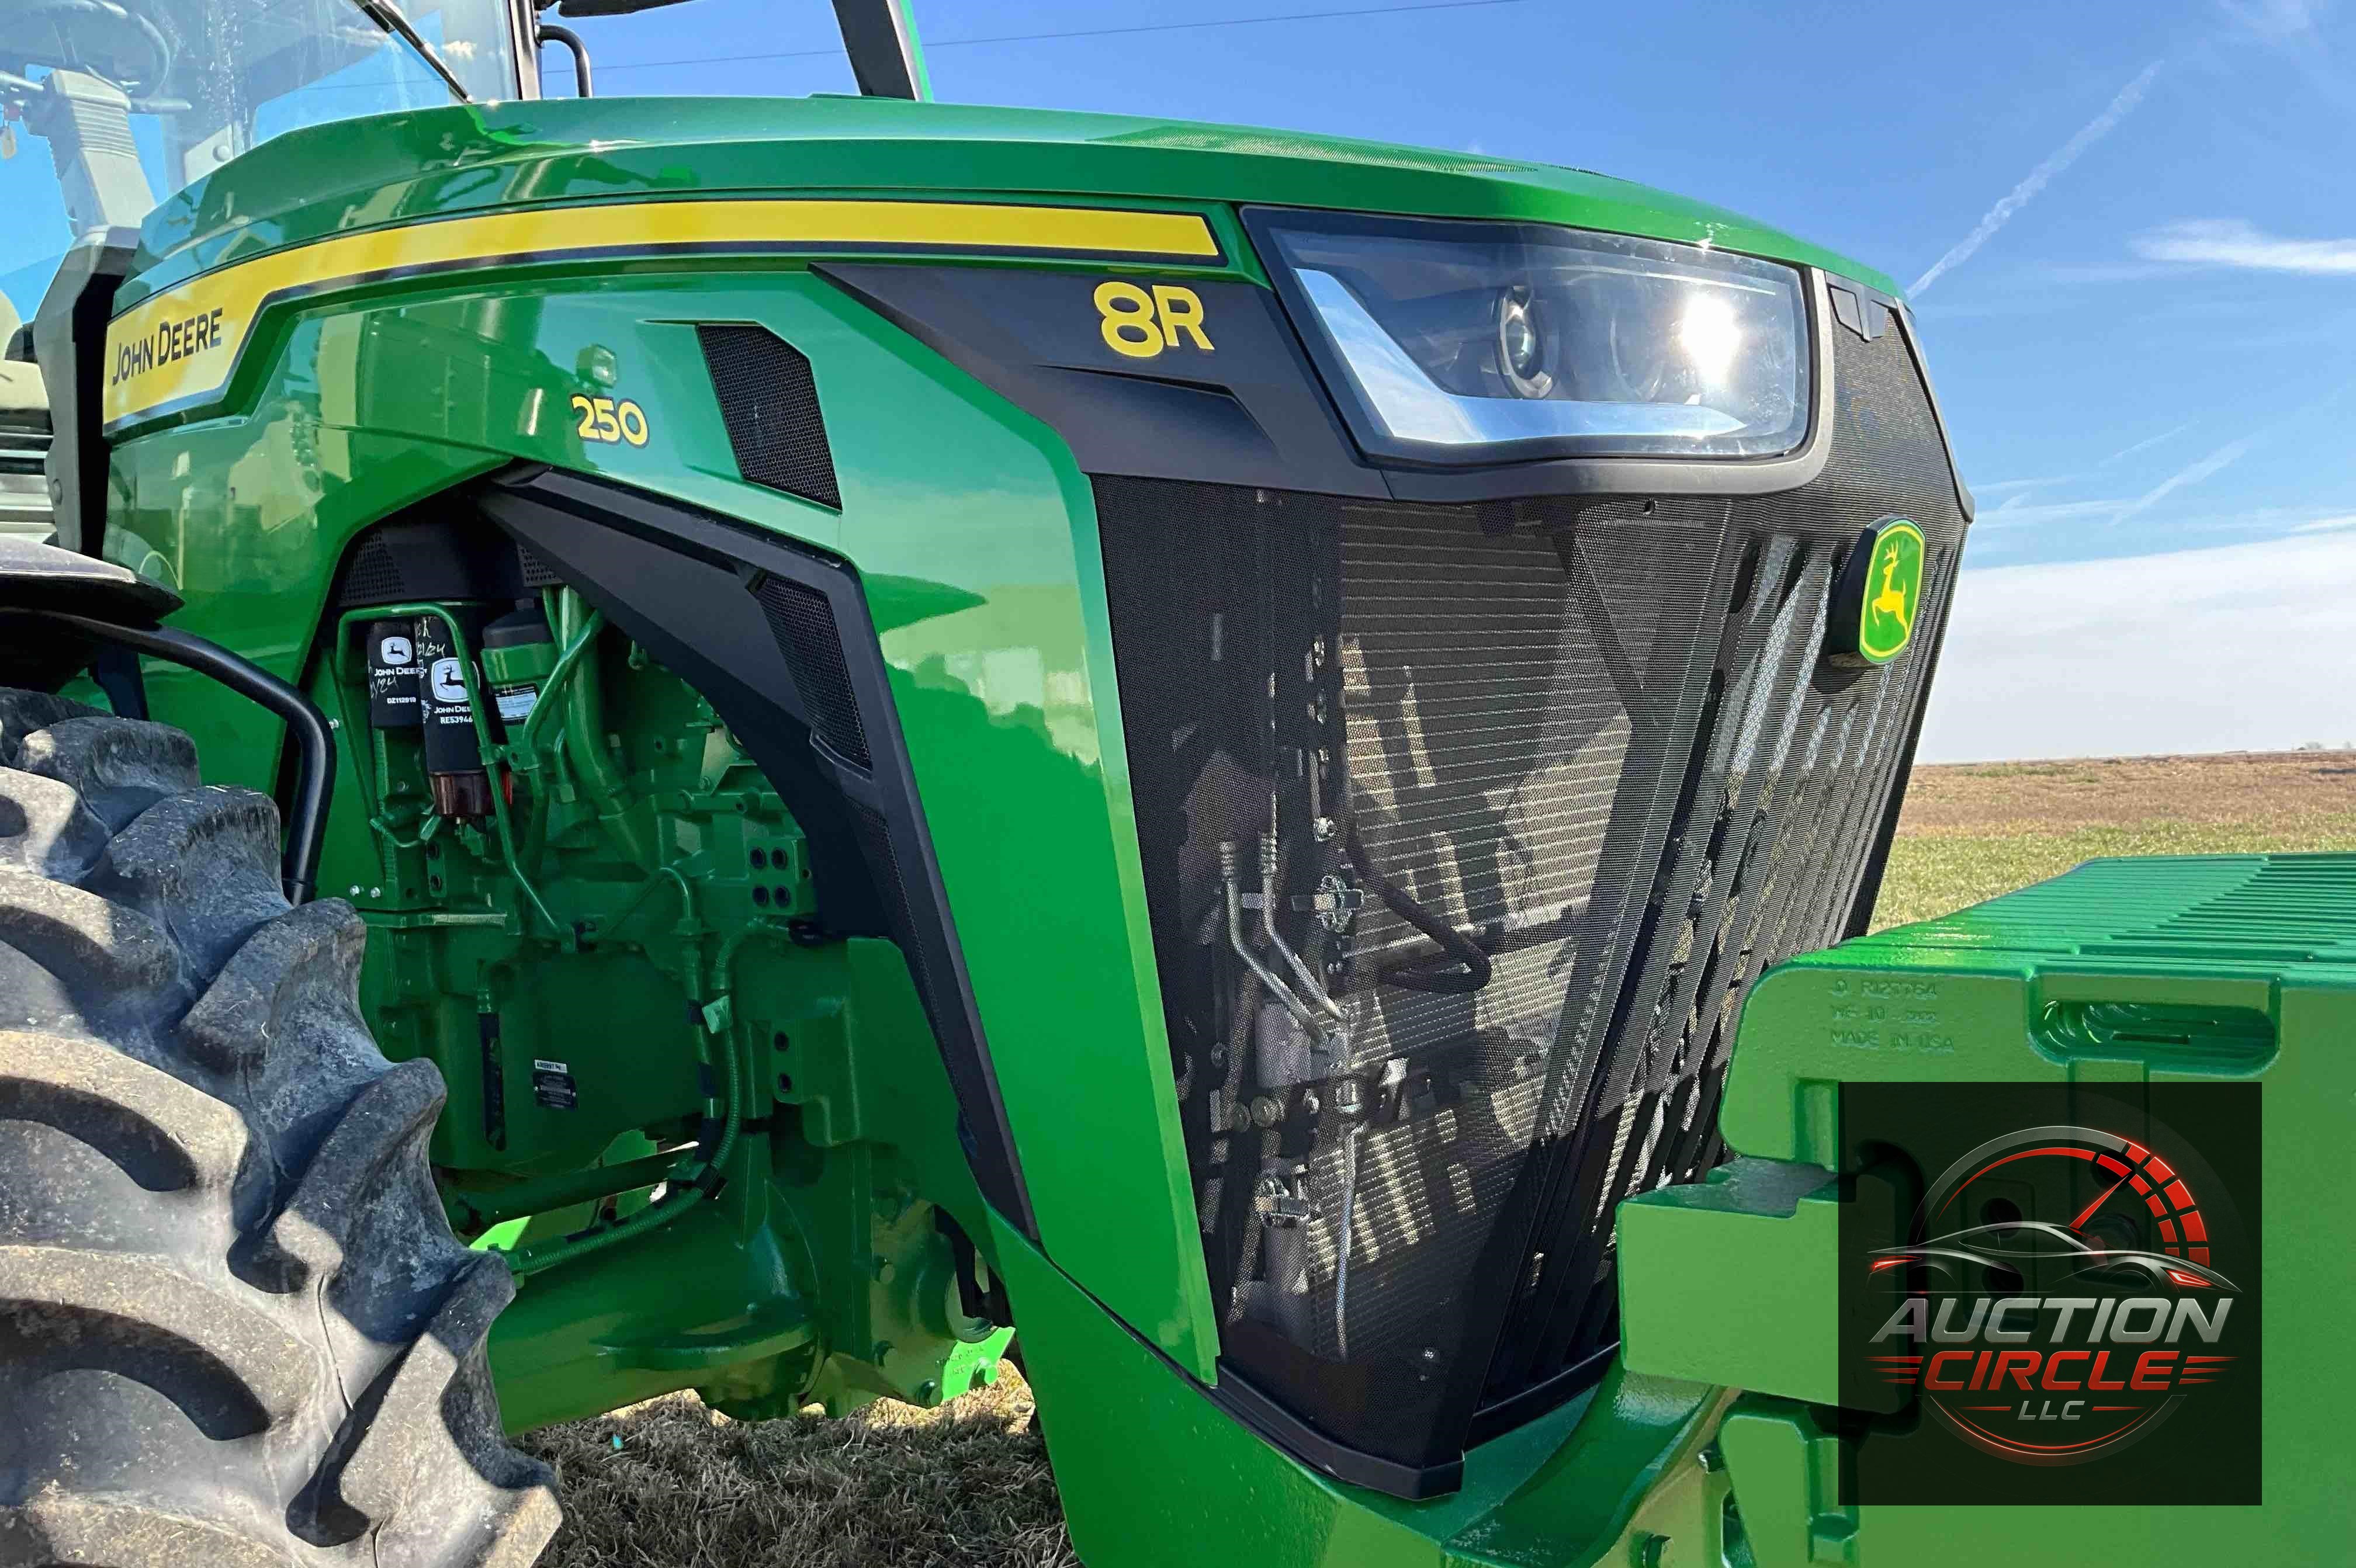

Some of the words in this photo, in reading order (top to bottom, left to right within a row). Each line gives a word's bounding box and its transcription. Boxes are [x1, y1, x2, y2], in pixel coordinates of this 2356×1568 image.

[1093, 281, 1215, 358] 8R
[112, 334, 154, 386] JOHN
[158, 307, 223, 366] DEERE
[570, 393, 650, 449] 250
[374, 668, 394, 677] JOHN
[396, 667, 421, 675] DEER
[440, 716, 473, 724] RE53946
[1830, 1029, 1880, 1049] MADE
[1889, 1032, 1911, 1051] IN
[1918, 1032, 1955, 1053] USA
